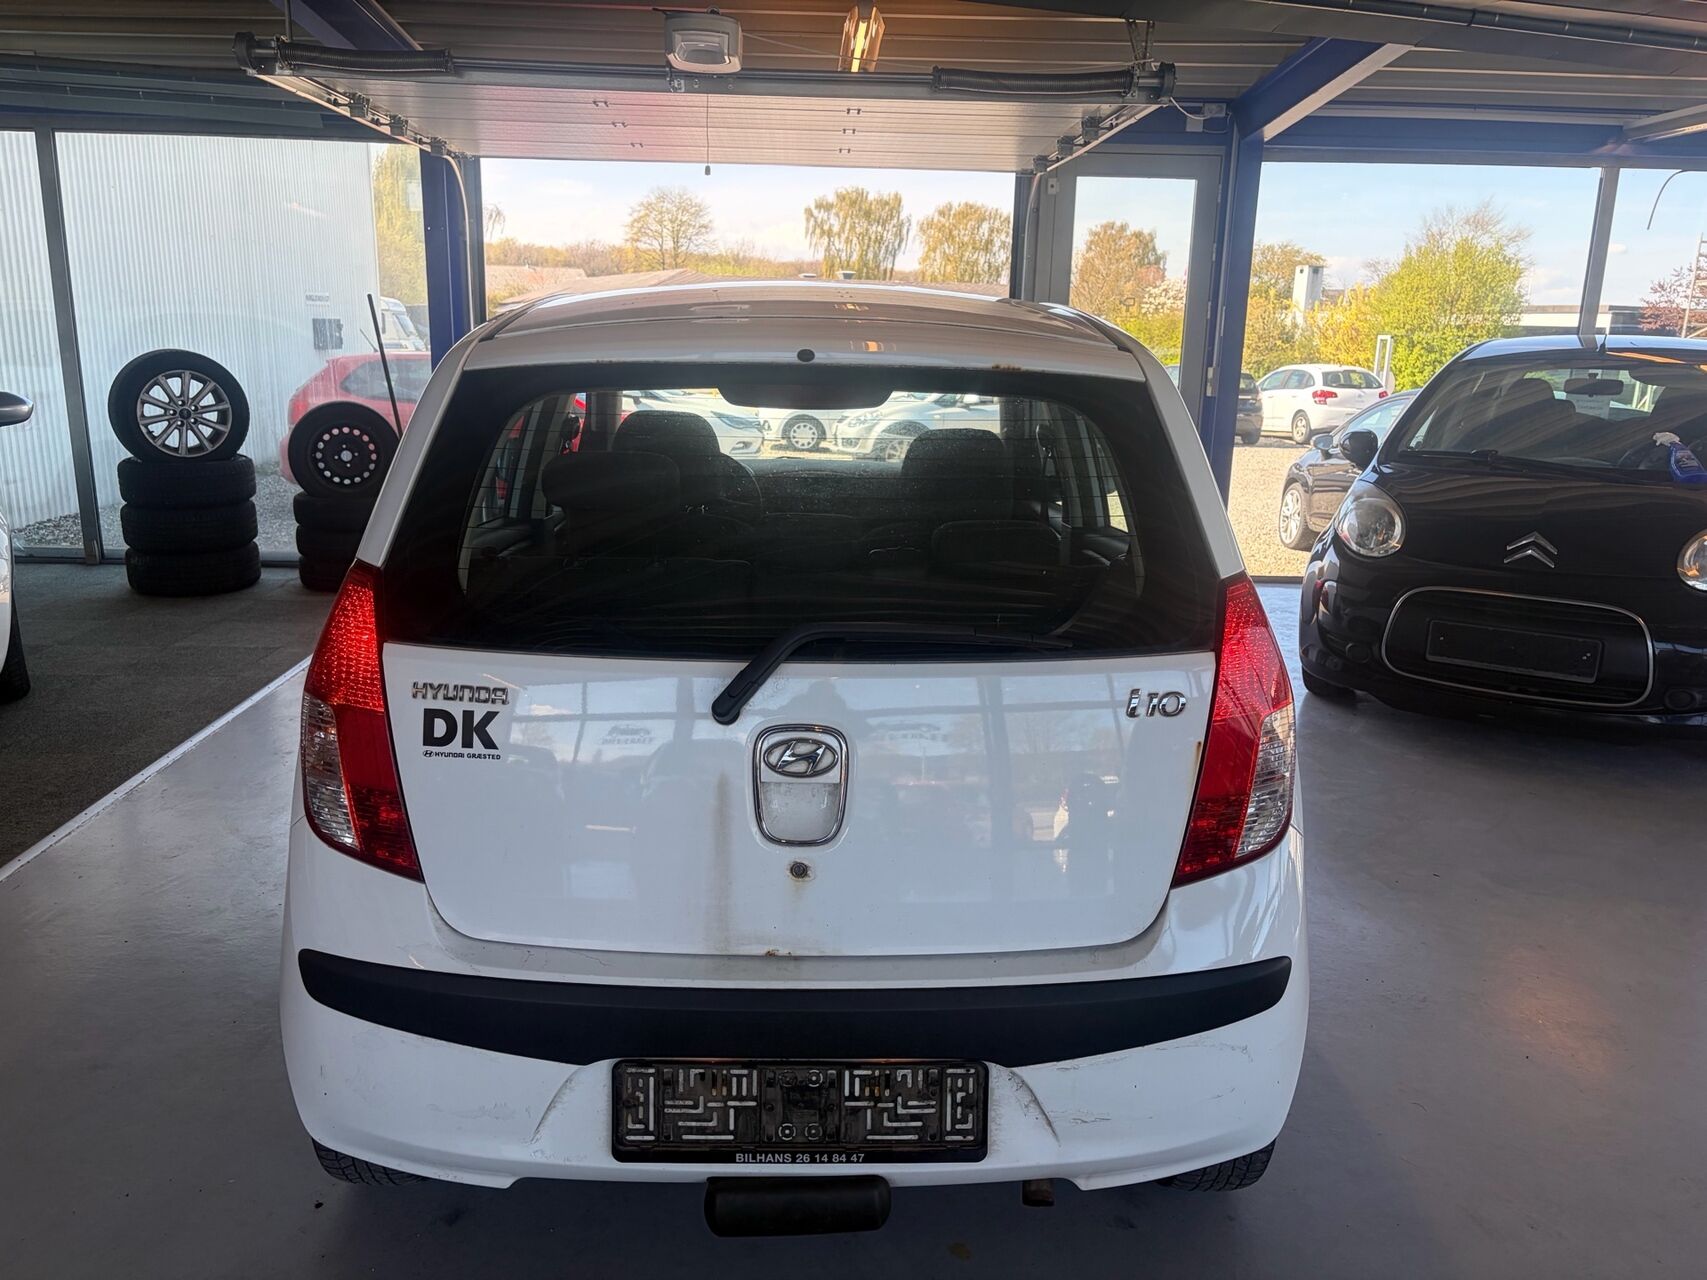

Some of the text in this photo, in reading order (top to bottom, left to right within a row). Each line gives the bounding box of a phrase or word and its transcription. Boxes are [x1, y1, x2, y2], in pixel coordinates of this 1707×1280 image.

[1126, 688, 1187, 718] i10
[422, 708, 500, 750] DK
[434, 751, 465, 759] HYUNDAI
[735, 1153, 865, 1163] BILHANS 26 14 84 47
